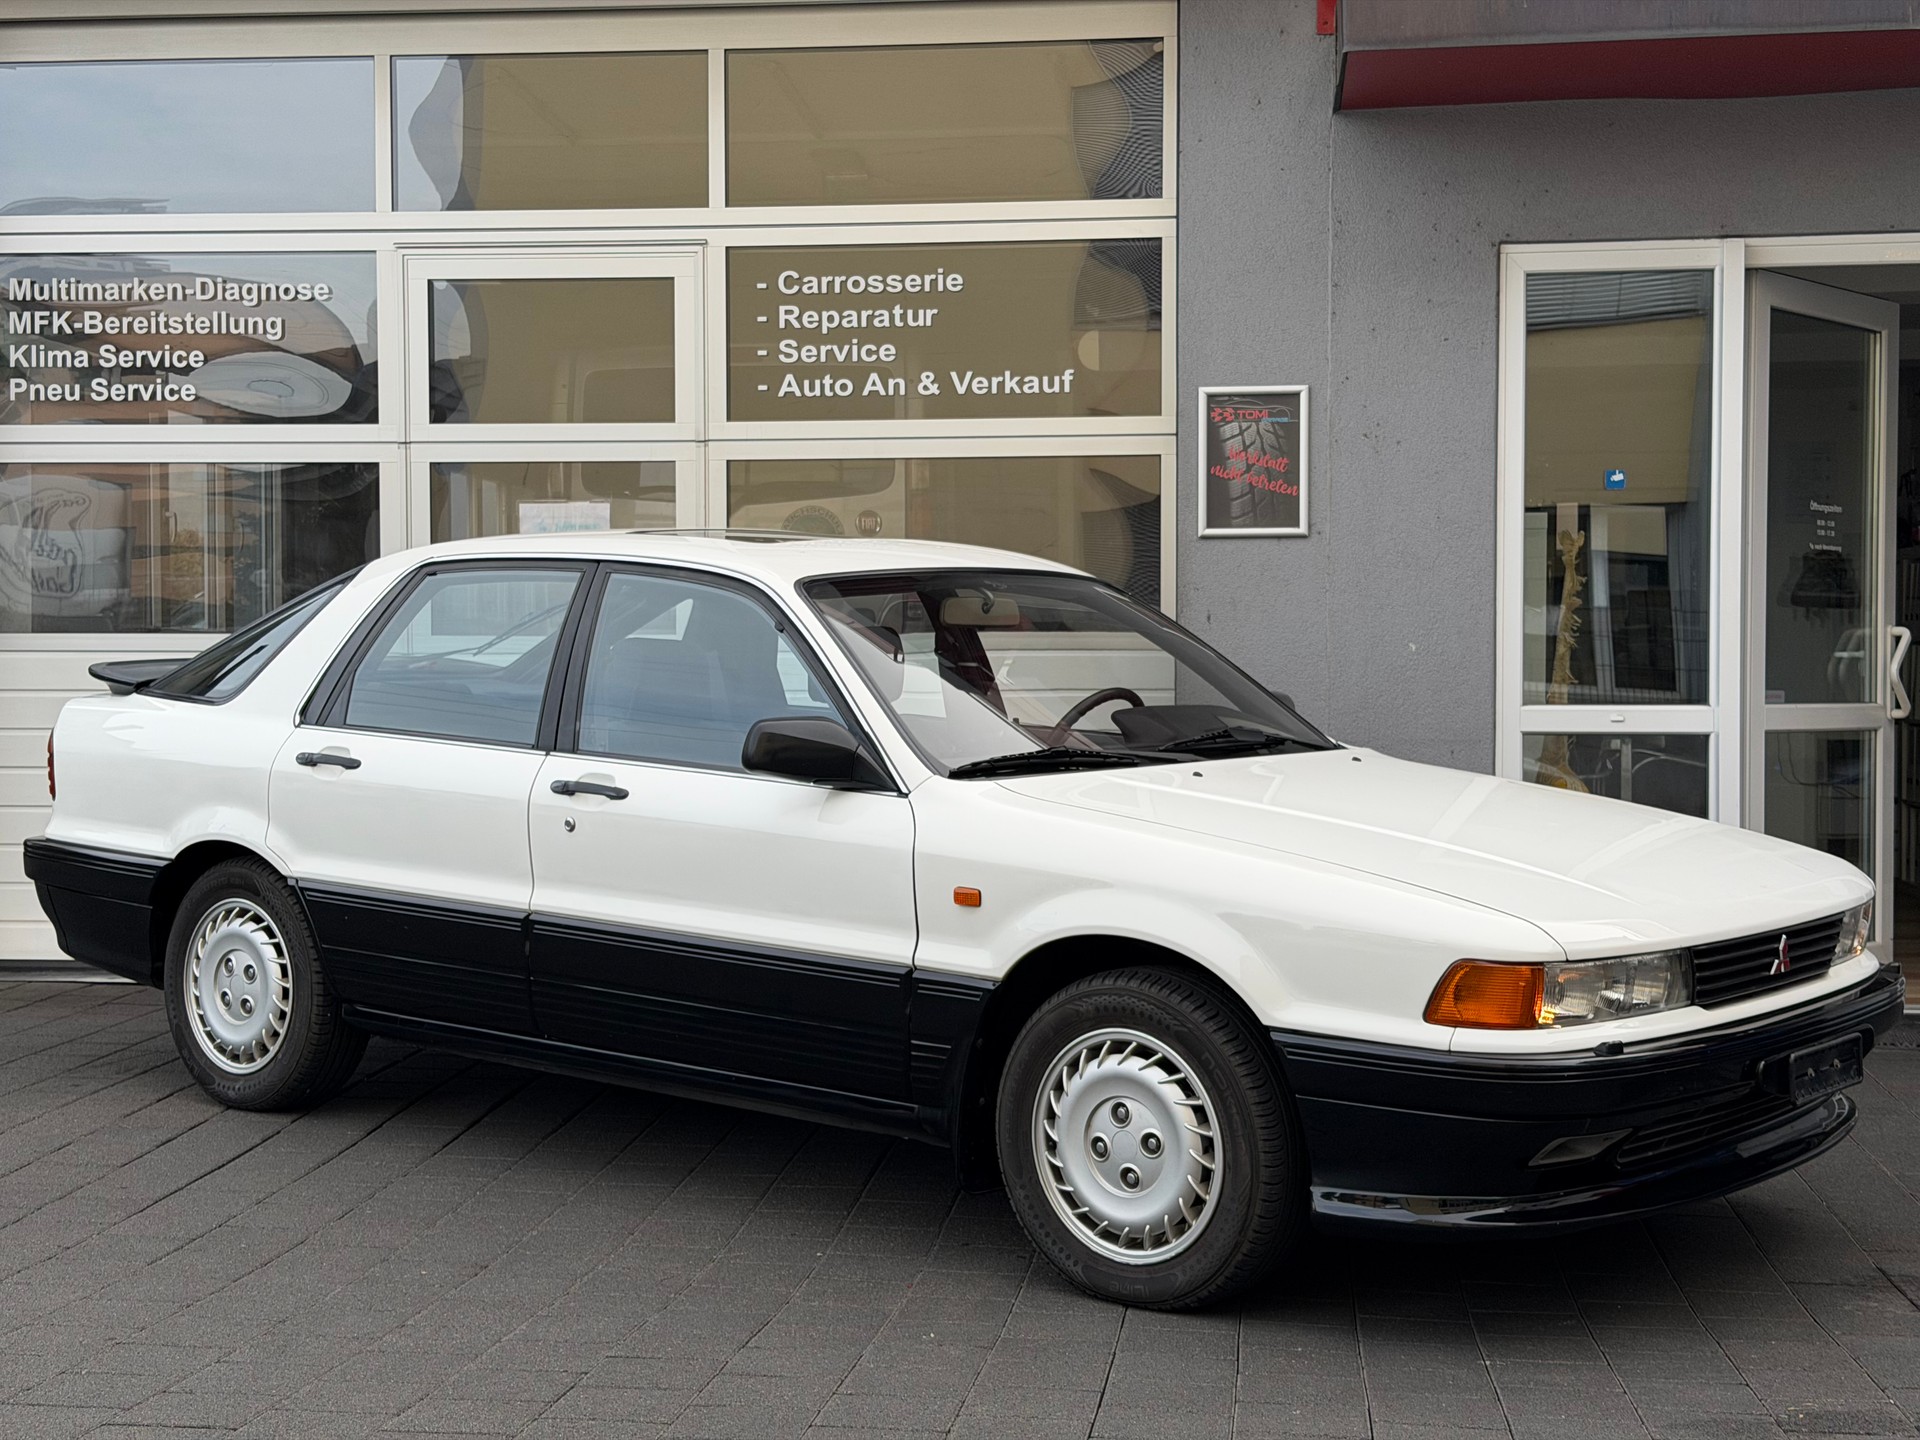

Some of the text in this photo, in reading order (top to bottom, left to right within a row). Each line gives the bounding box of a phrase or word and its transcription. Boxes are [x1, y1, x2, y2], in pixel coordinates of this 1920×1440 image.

[9, 277, 332, 307] Multimarken-Diagnose
[778, 268, 964, 294] Carrosserie
[9, 311, 284, 341] MFK-Bereitstellung
[778, 303, 938, 334] Reparatur
[9, 345, 205, 369] Klima Service
[778, 339, 897, 364] Service
[9, 378, 197, 402] Pneu Service
[778, 373, 854, 397] Auto
[862, 372, 906, 396] An
[917, 371, 940, 396] &
[950, 369, 1075, 395] Verkauf
[1237, 409, 1269, 420] TOMI
[1210, 464, 1245, 482] nicht
[1247, 471, 1298, 496] betreten
